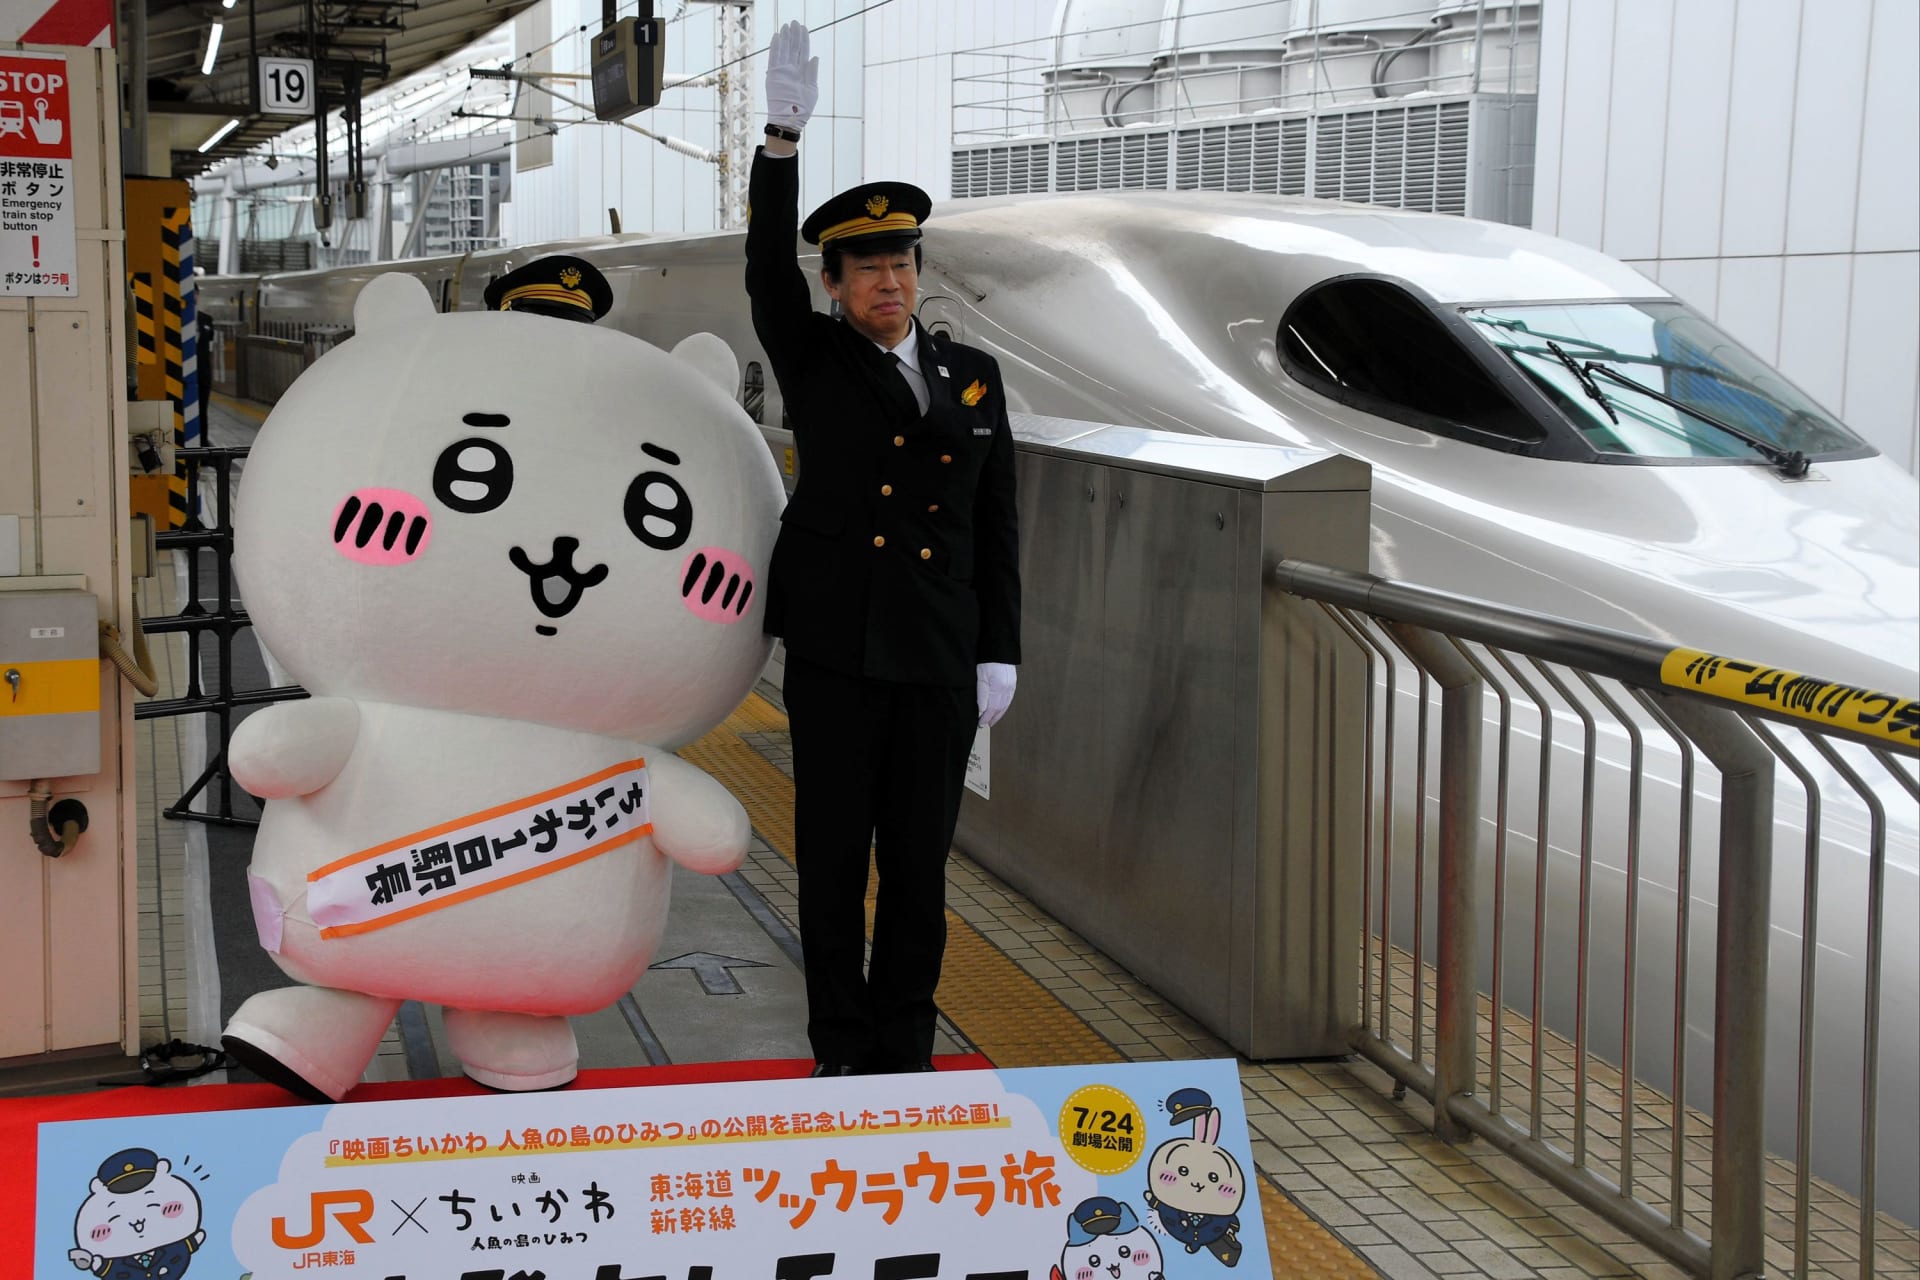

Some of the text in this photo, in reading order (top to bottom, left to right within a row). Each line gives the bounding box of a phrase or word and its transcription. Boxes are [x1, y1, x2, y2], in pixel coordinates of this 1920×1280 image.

[640, 24, 650, 43] 1
[268, 68, 306, 103] 19
[0, 161, 64, 179] 非常停止
[2, 181, 64, 197] ボタン
[2, 199, 62, 211] Emergency
[2, 210, 54, 222] train stop
[3, 221, 38, 231] button
[365, 782, 643, 905] ちいかわ1日駅長
[1073, 1106, 1134, 1135] 7/24
[329, 1132, 488, 1161] 『映画ちいかわ
[1072, 1131, 1133, 1153] 劇場公開
[511, 1172, 541, 1184] 映画
[649, 1170, 734, 1203] 東海道
[439, 1181, 615, 1231] ちいかわ
[271, 1189, 376, 1250] JR
[650, 1205, 736, 1235] 新幹線
[471, 1232, 588, 1251] 人魚の島のひみつ
[292, 1250, 356, 1270] JR東海
